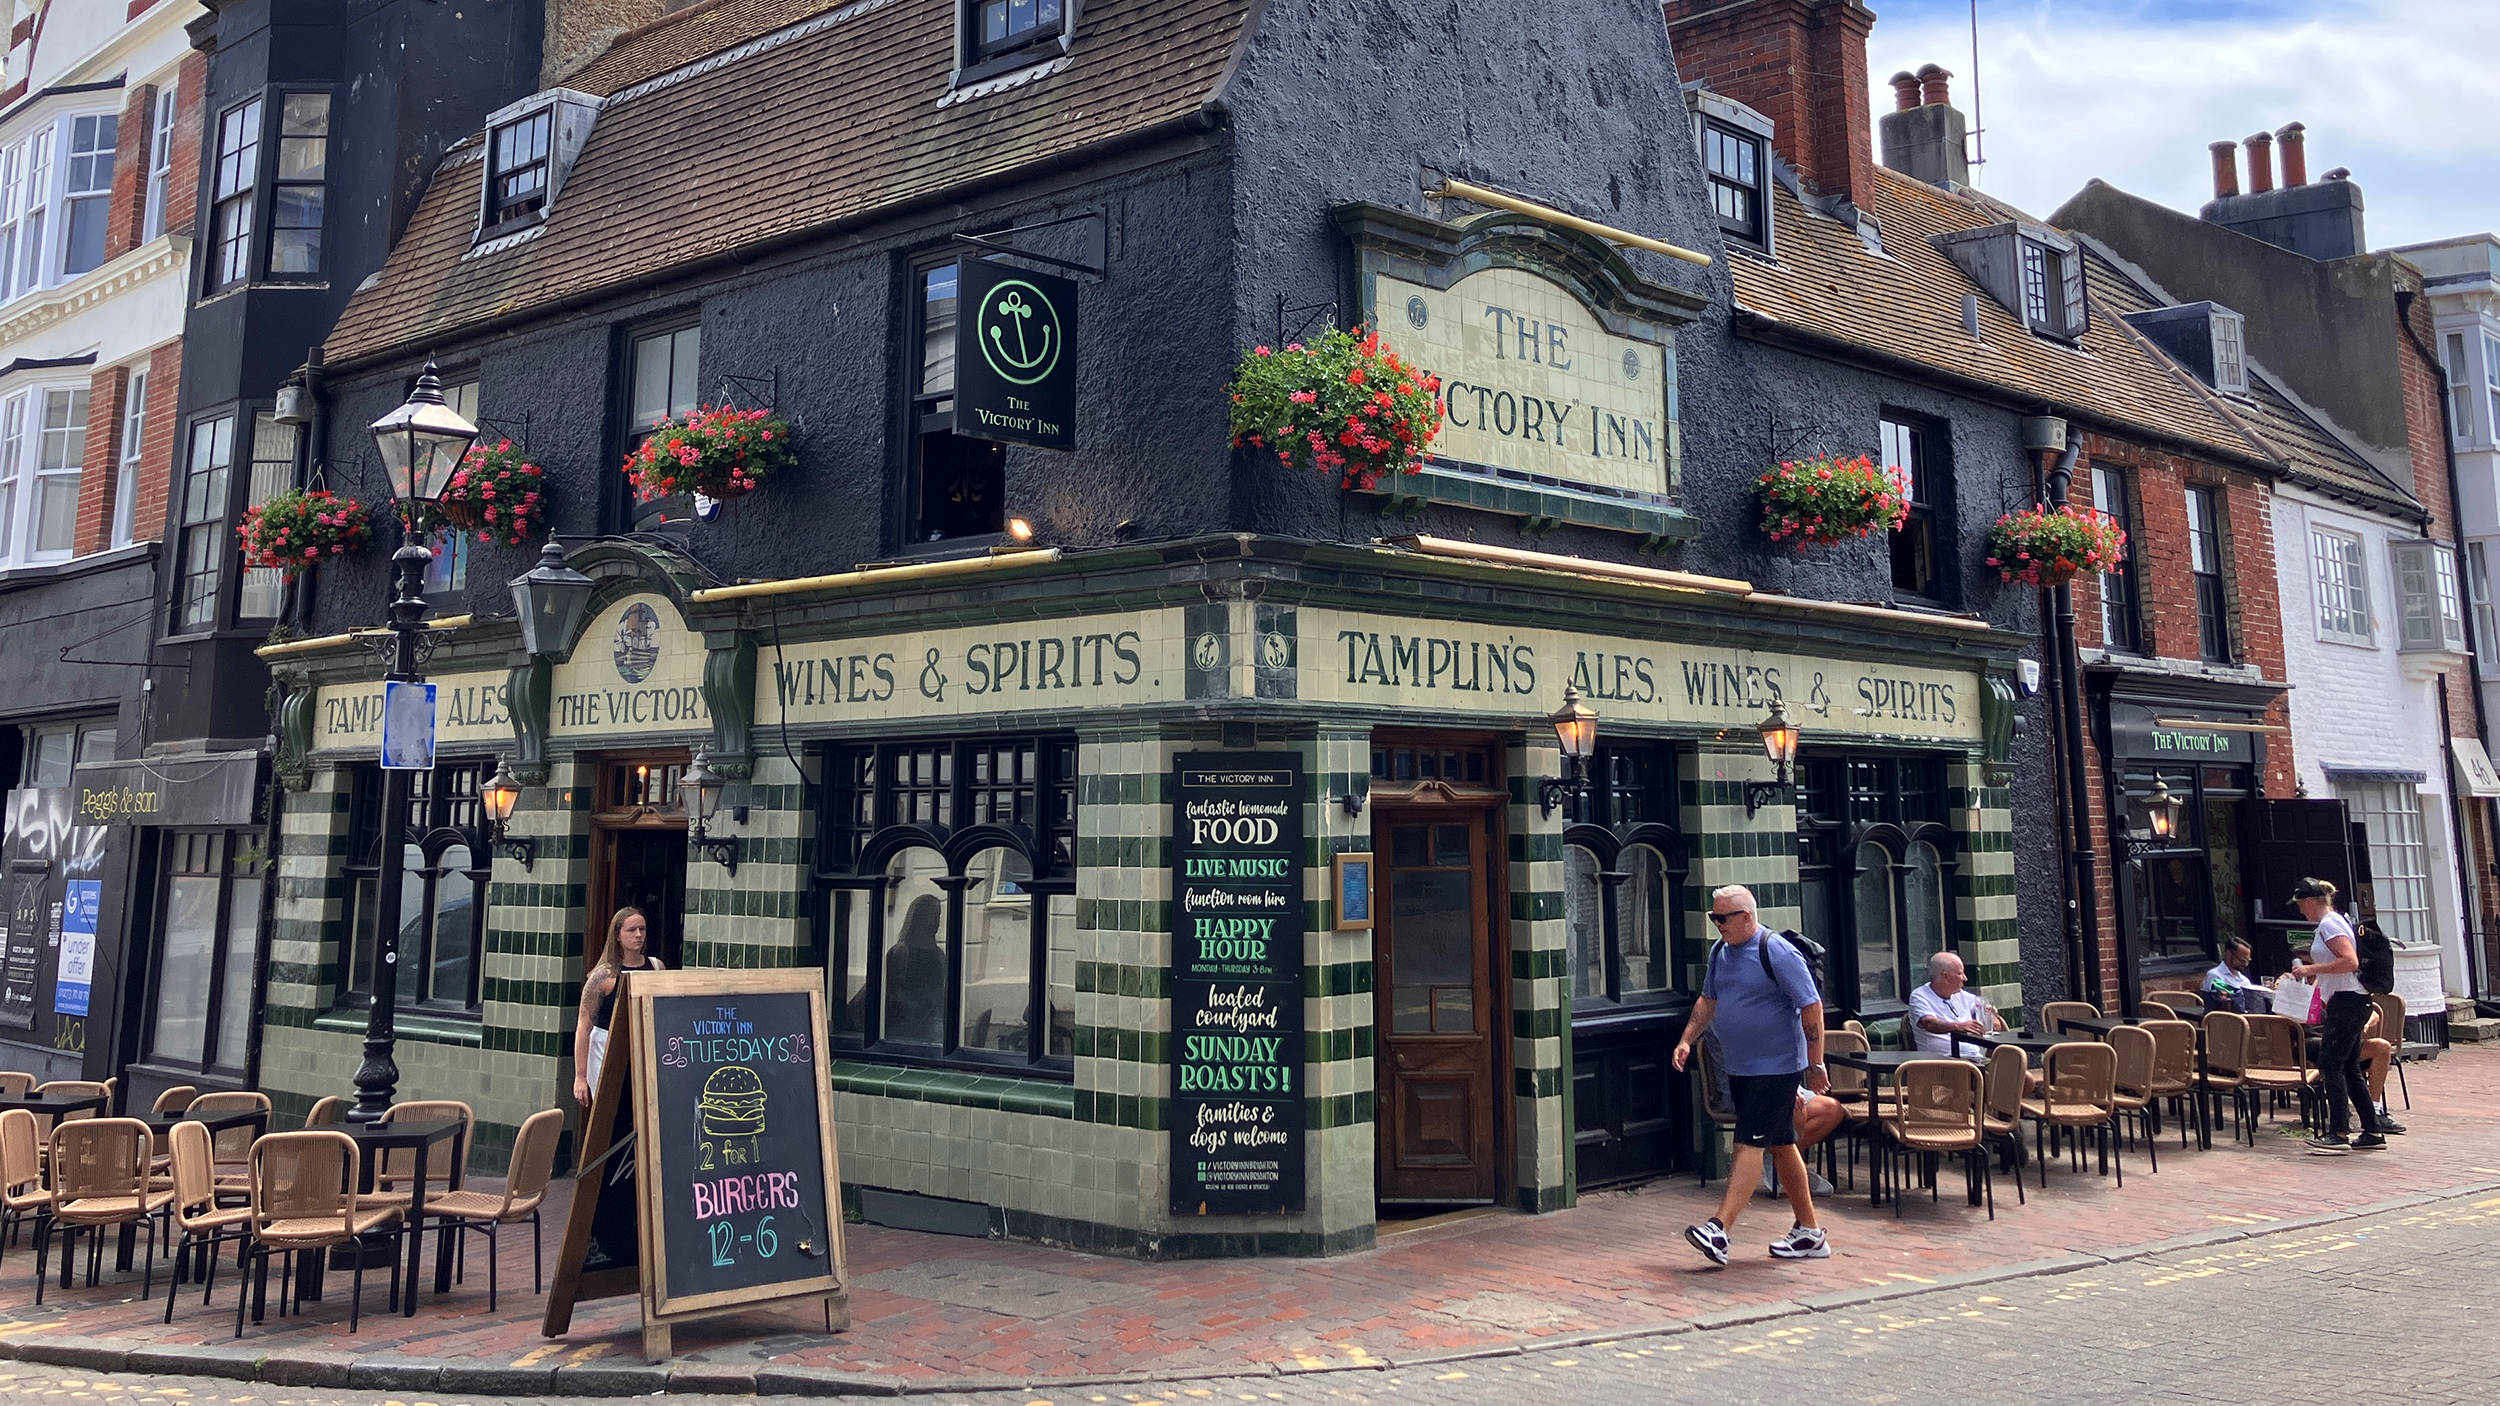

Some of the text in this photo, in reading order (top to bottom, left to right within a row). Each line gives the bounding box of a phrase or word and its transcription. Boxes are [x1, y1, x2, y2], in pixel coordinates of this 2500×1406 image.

[1484, 305, 1572, 371] THE
[1007, 396, 1030, 411] THE
[1038, 419, 1059, 435] INN
[1590, 406, 1656, 463] INN
[774, 653, 896, 706] WINES
[919, 647, 949, 702] &
[1337, 630, 1535, 694] TAMPLIN'S
[1573, 652, 1663, 703] ALES.
[1681, 661, 1783, 710] WINES
[1810, 671, 1831, 718] &
[325, 694, 385, 734] TAMP
[557, 694, 601, 727] THE
[2151, 731, 2172, 751] THE
[2213, 734, 2229, 753] INN
[1198, 774, 1274, 783] THE VICTORY INN
[2470, 758, 2491, 785] 46
[120, 786, 133, 813] &
[1185, 799, 1289, 819] fantastic homemade
[1192, 817, 1279, 845] FOOD
[1185, 858, 1290, 878] LIVE MUSIC
[1183, 887, 1286, 913] function room hire
[1193, 918, 1277, 940] HAPPY
[68, 937, 90, 955] under
[1198, 939, 1268, 961] HOUR
[67, 956, 86, 975] offer
[1191, 964, 1218, 973] MONDAY
[1222, 964, 1250, 974] THURSDAY
[1208, 983, 1265, 1009] heated
[716, 1007, 738, 1020] THE
[1195, 1006, 1278, 1034] courtyard
[693, 1021, 753, 1035] VICTORY INN
[683, 1036, 790, 1063] TUESDAYS
[1184, 1035, 1284, 1063] SUNDAY
[1195, 1101, 1275, 1128] families &
[699, 1142, 715, 1170] 2
[750, 1135, 760, 1163] 1
[1189, 1125, 1288, 1154] dogs welcome
[694, 1171, 799, 1220] BURGERS
